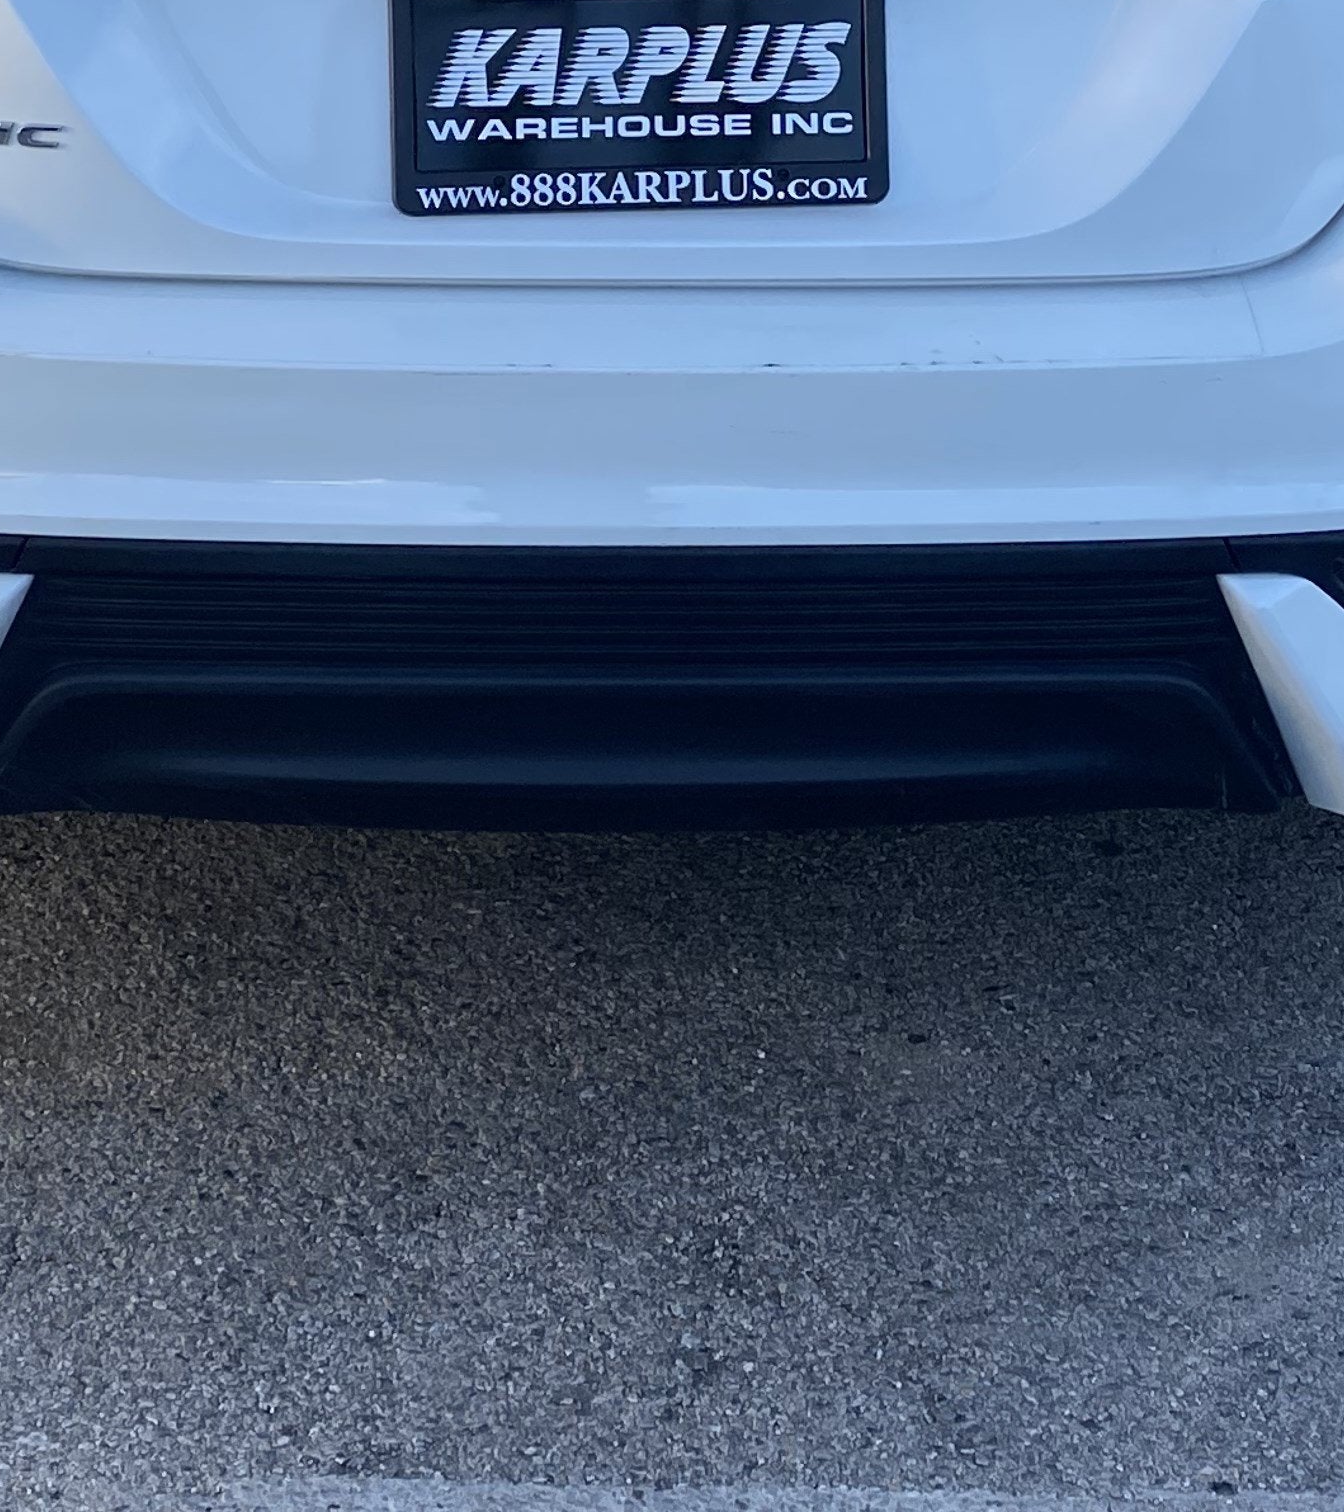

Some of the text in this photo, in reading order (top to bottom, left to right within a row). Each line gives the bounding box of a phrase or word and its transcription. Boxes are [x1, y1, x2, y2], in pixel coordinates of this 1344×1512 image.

[426, 22, 852, 109] KARPLUS
[427, 112, 854, 141] WAREHOUSE INC
